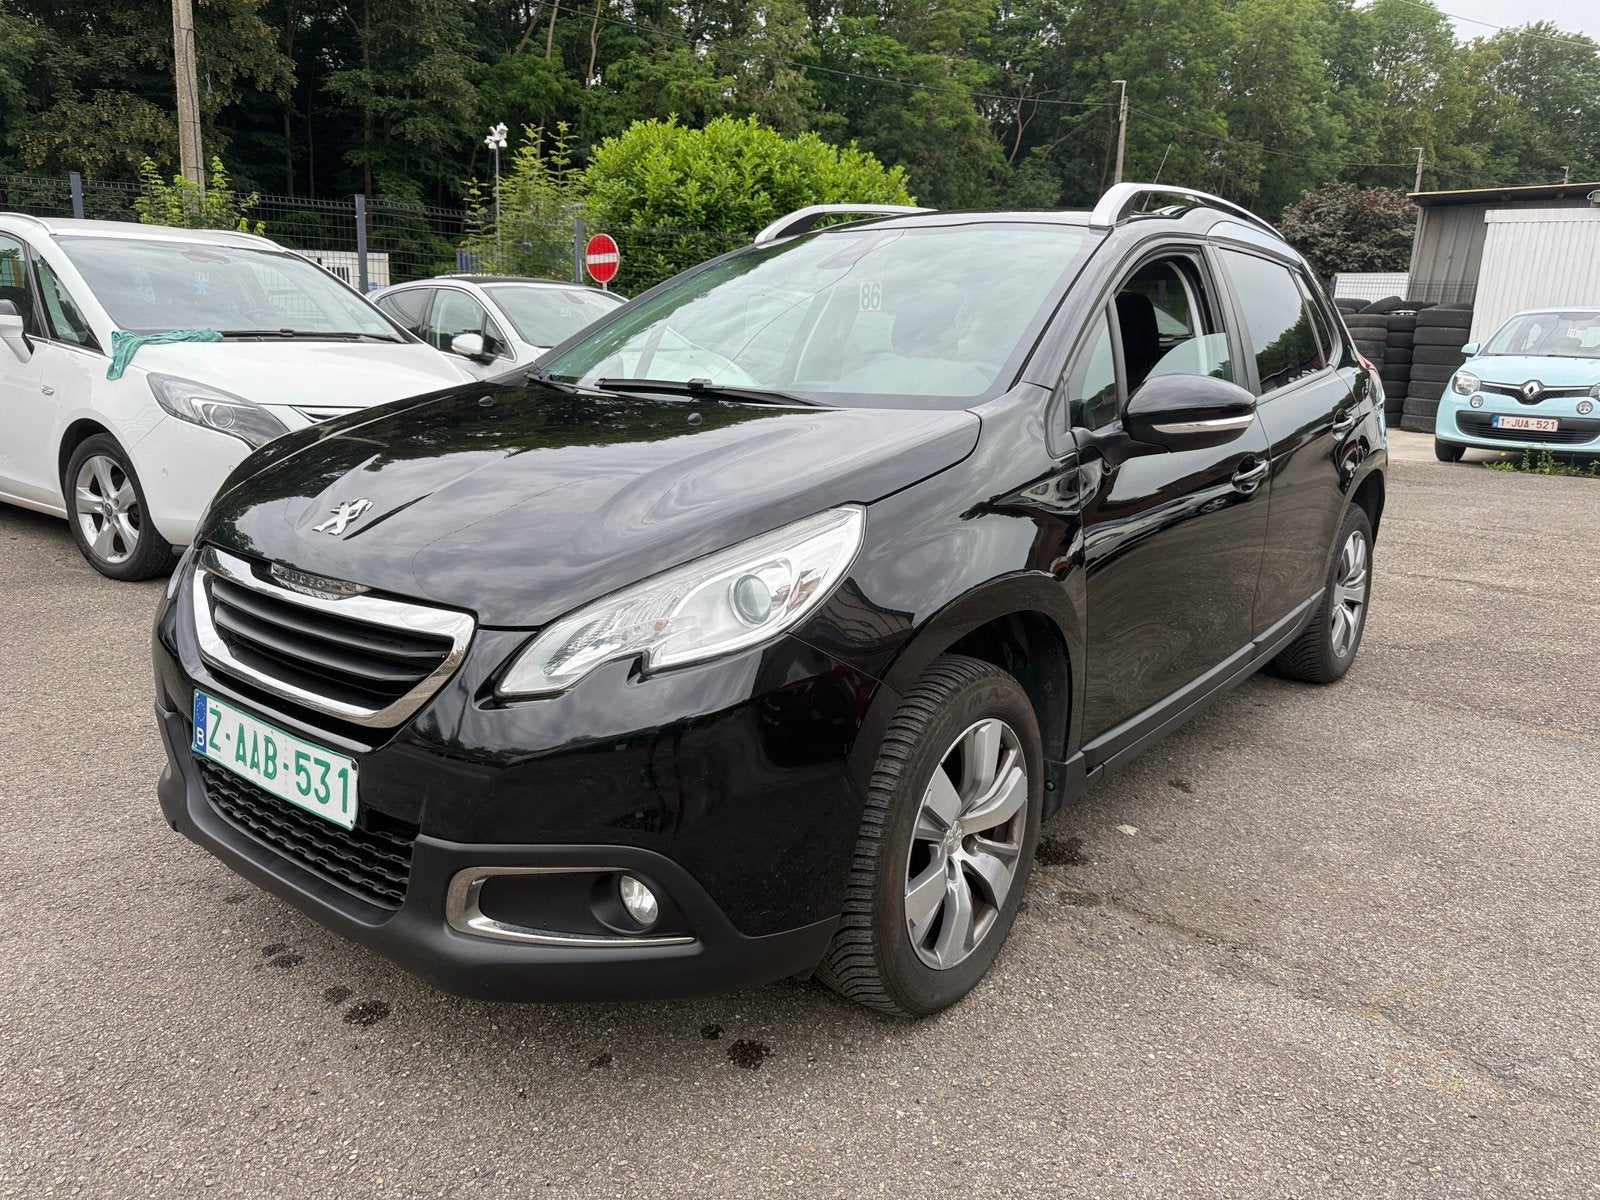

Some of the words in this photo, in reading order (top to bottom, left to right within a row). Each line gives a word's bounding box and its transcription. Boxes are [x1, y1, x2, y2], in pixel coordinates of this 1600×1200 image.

[861, 282, 881, 310] 86
[1501, 418, 1556, 430] 1-JUA-521
[208, 707, 349, 814] Z-AAB-531
